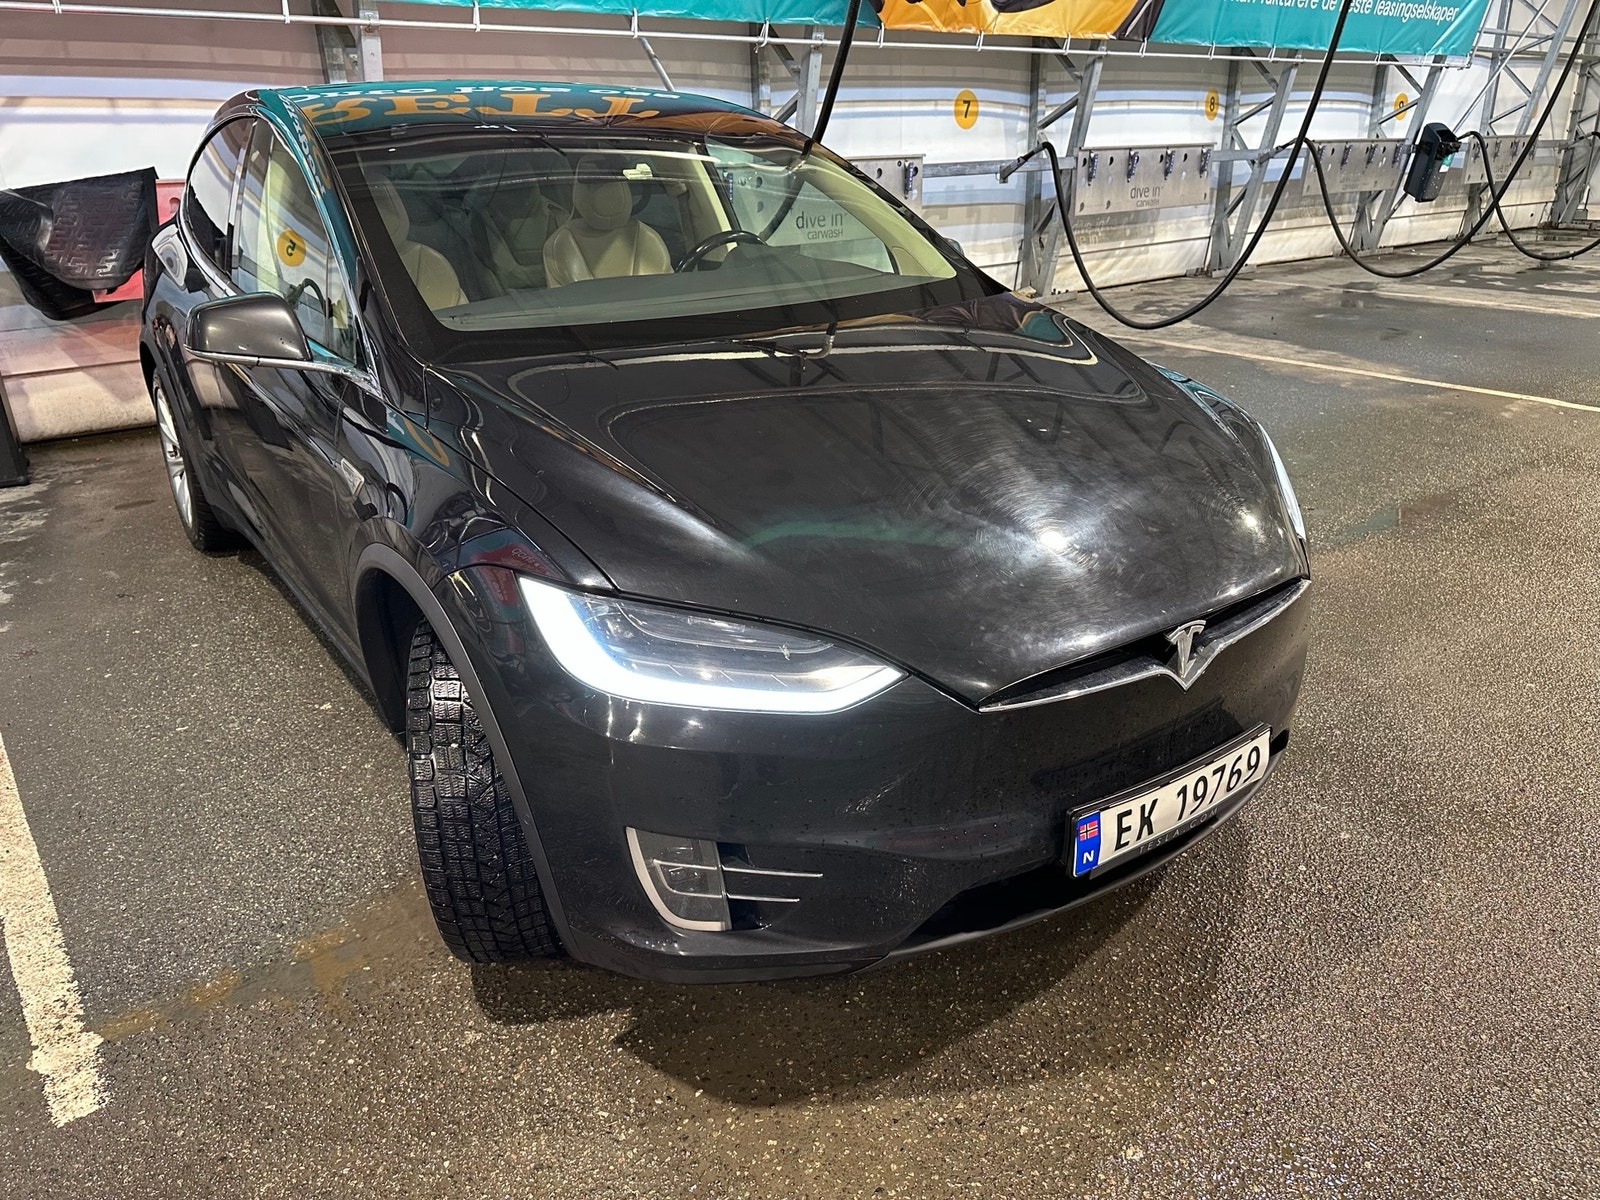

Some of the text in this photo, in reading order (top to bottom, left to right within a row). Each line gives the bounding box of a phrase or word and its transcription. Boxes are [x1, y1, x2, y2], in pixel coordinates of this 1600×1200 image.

[1374, 0, 1459, 26] leasingselskaper
[962, 99, 971, 119] 7
[1209, 96, 1215, 112] 8
[1130, 185, 1161, 199] dive in
[795, 210, 843, 230] dive in
[1114, 745, 1261, 852] EK 19769
[1139, 806, 1219, 855] TESLA.COM
[1083, 850, 1095, 864] N
